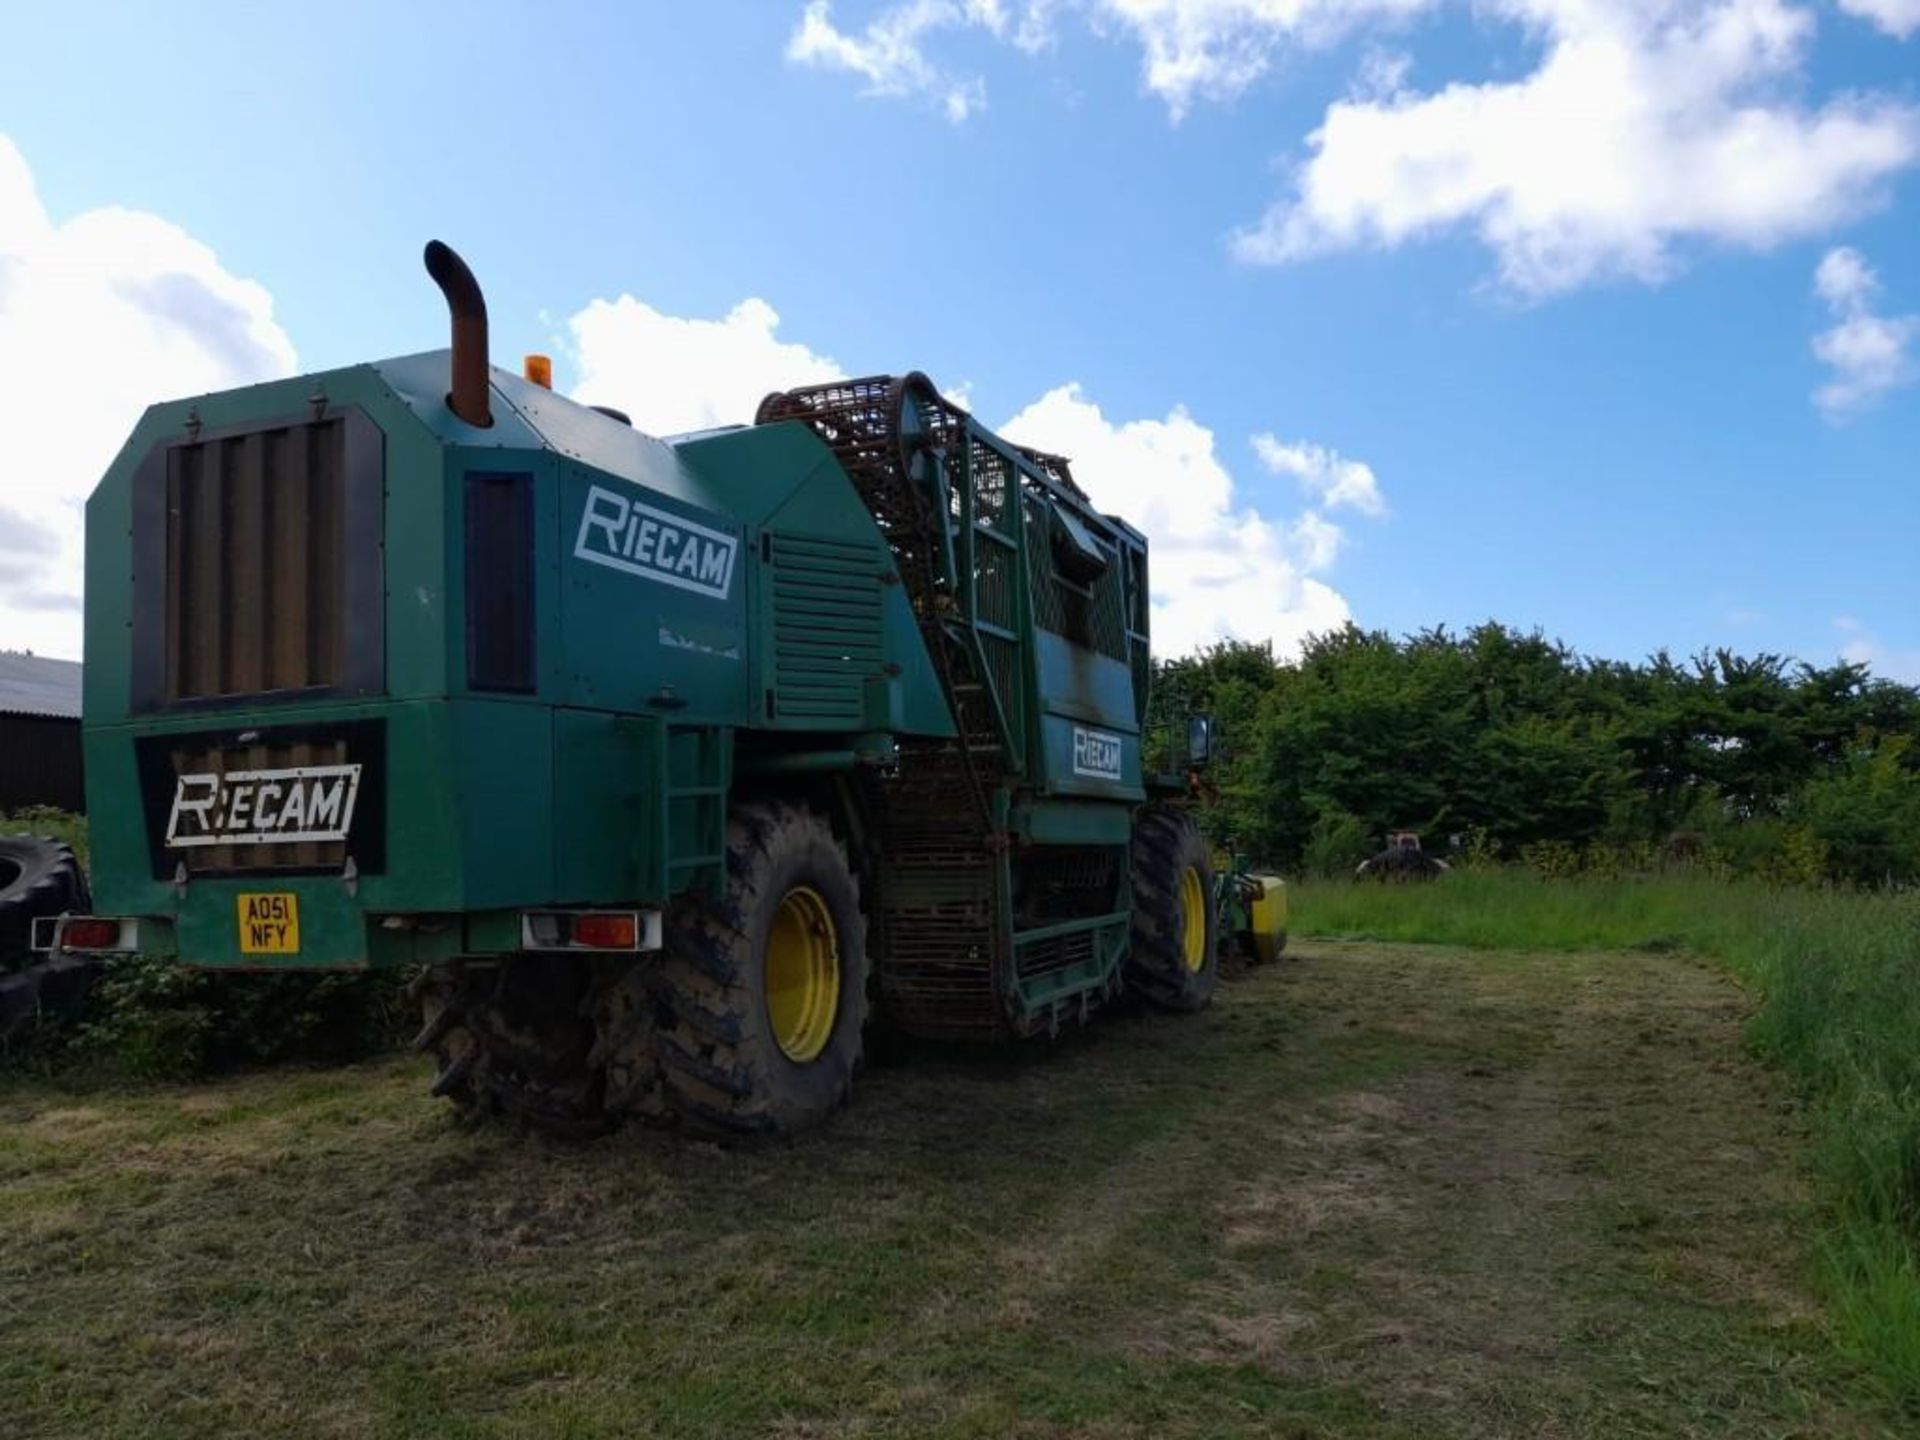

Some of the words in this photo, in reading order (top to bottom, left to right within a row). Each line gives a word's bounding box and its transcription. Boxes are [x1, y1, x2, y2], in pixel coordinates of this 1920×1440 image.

[574, 485, 737, 599] RIECAM
[1074, 727, 1121, 780] RIECAM
[251, 924, 287, 948] NFY
